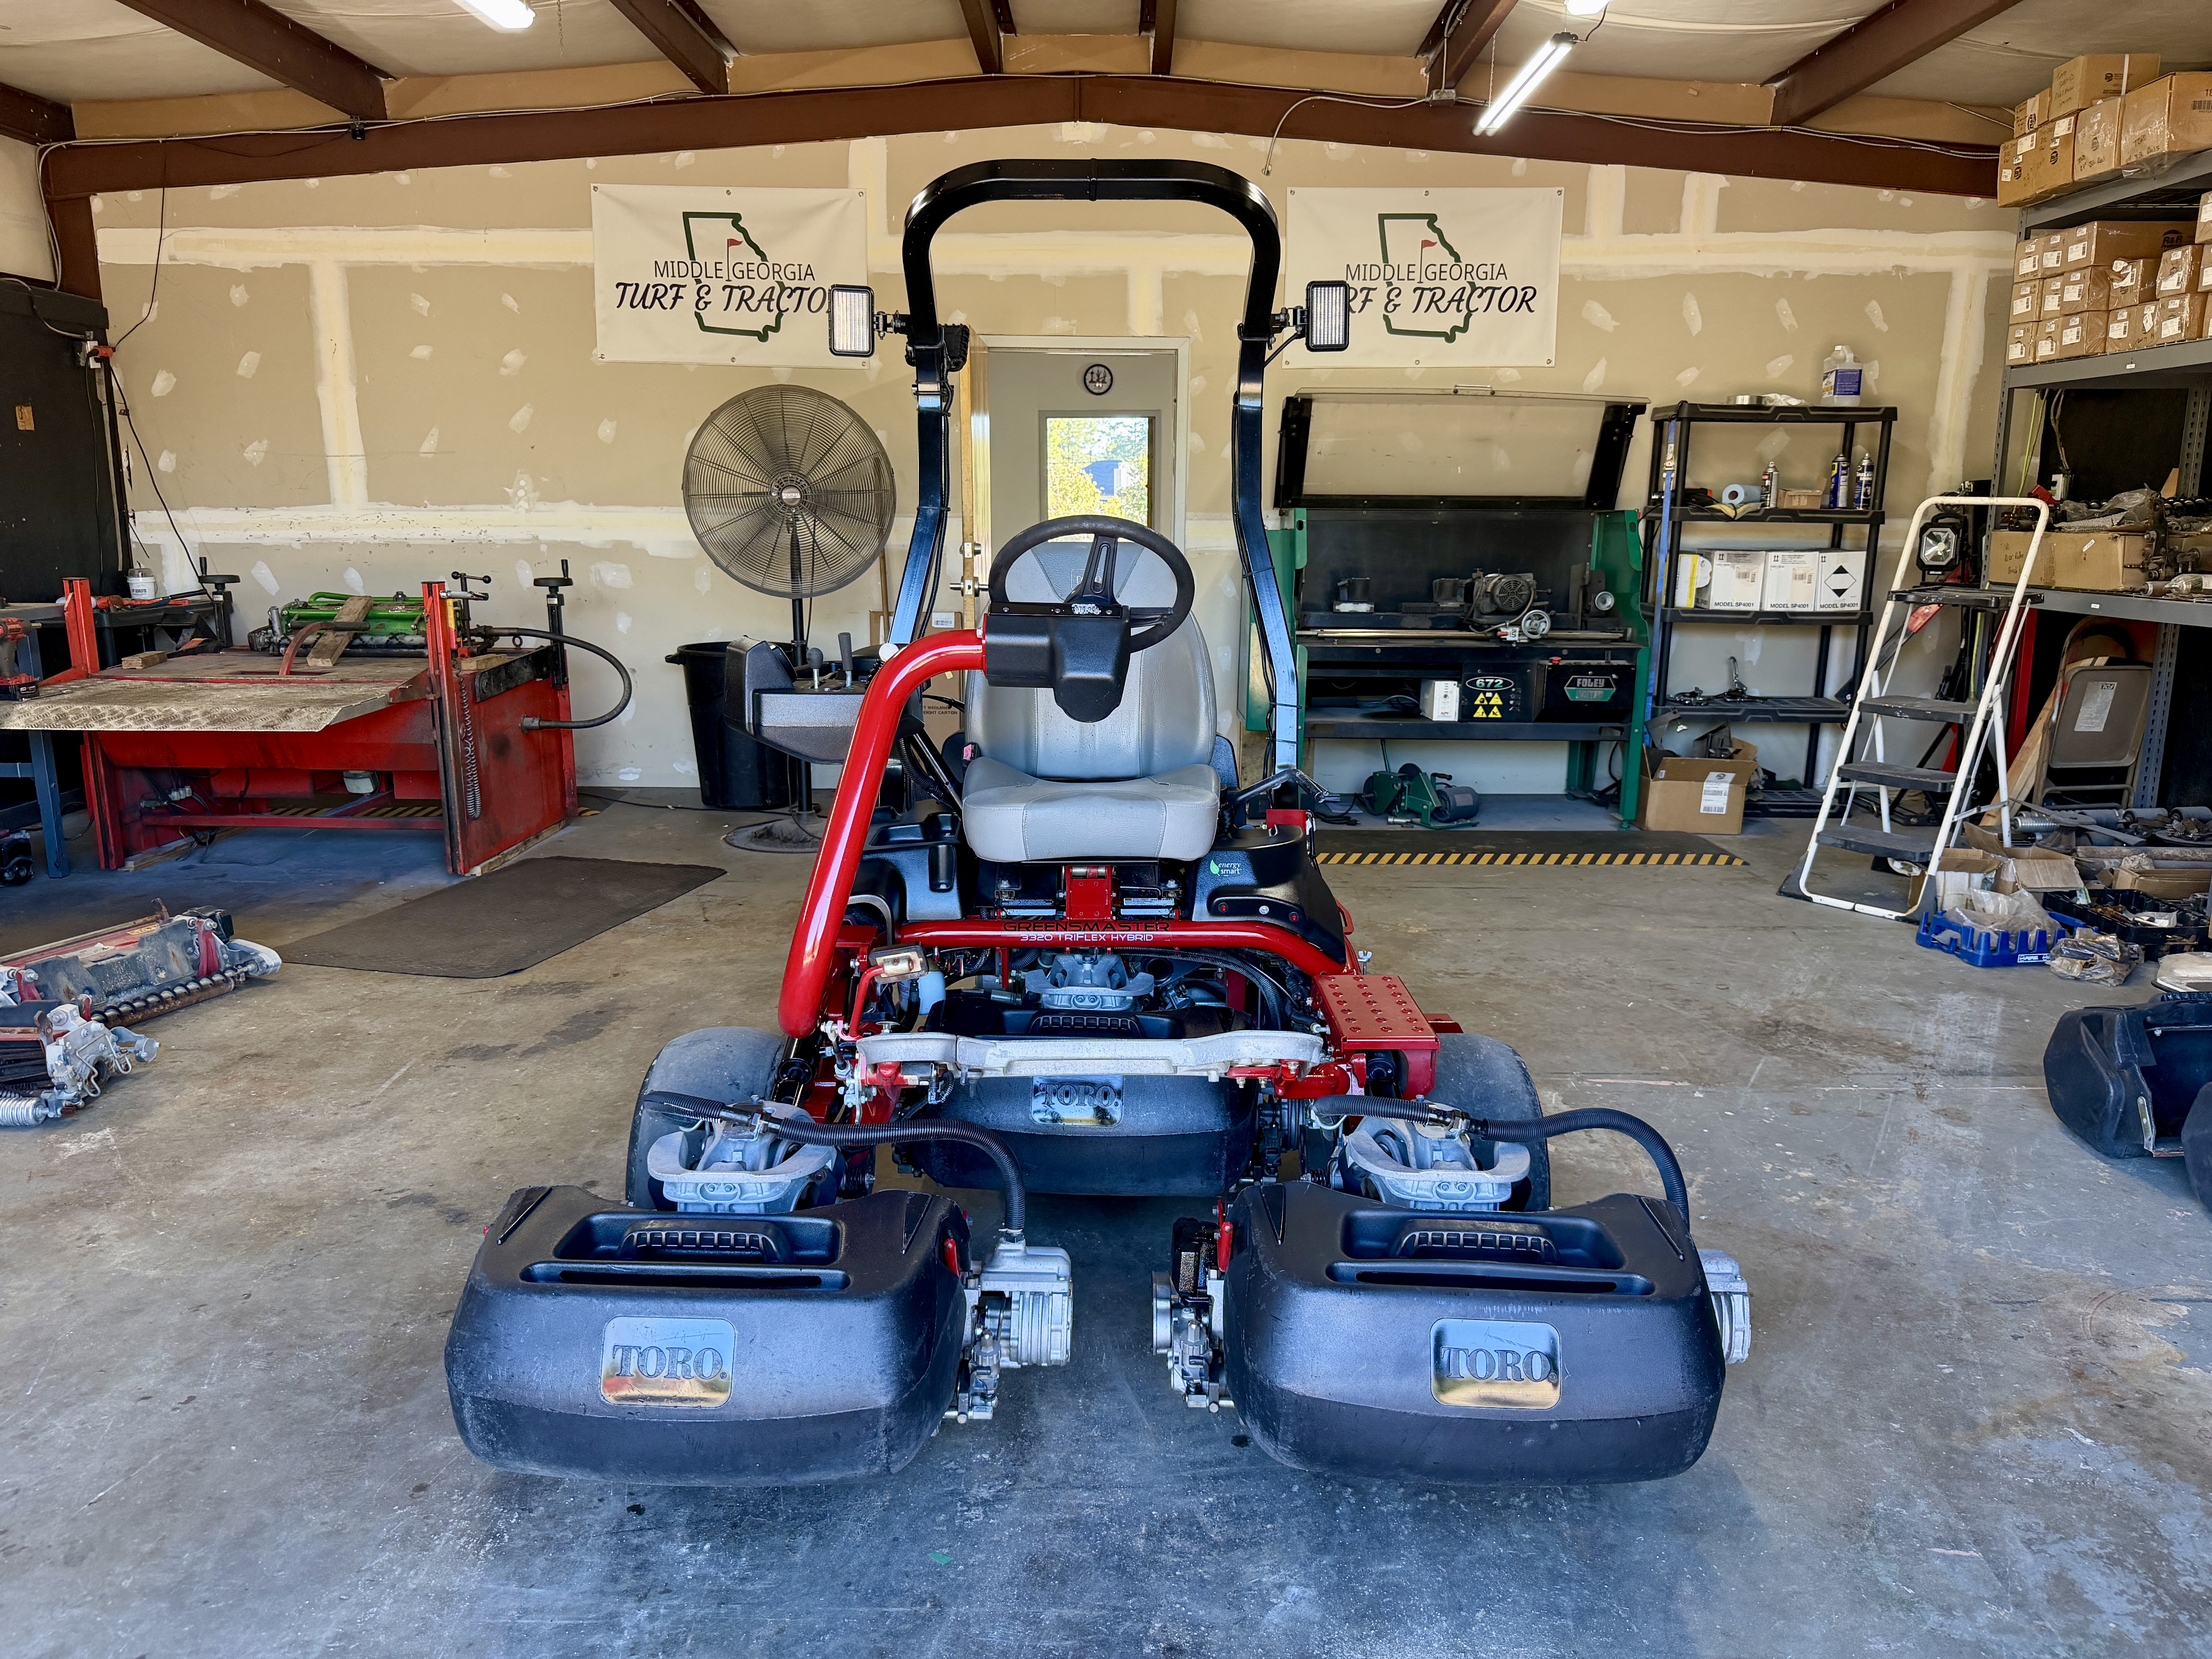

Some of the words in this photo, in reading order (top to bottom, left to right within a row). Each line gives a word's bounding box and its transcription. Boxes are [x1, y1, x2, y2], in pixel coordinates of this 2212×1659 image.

[2163, 235, 2183, 244] R&R
[654, 261, 723, 279] MIDDLE
[732, 262, 815, 281] GEORGIA
[1346, 263, 1416, 281] MIDDLE
[1425, 263, 1508, 281] GEORGIA
[616, 282, 687, 309] TURF
[695, 285, 712, 311] &
[722, 285, 828, 313] TRACTO
[1384, 287, 1402, 313] &
[1412, 286, 1537, 313] TRACTOR
[1476, 679, 1503, 688] 672
[1577, 678, 1605, 687] FOLEY
[1003, 921, 1170, 932] GREENSMASTER
[613, 1345, 723, 1380] TORO
[1441, 1347, 1551, 1382] TORO
